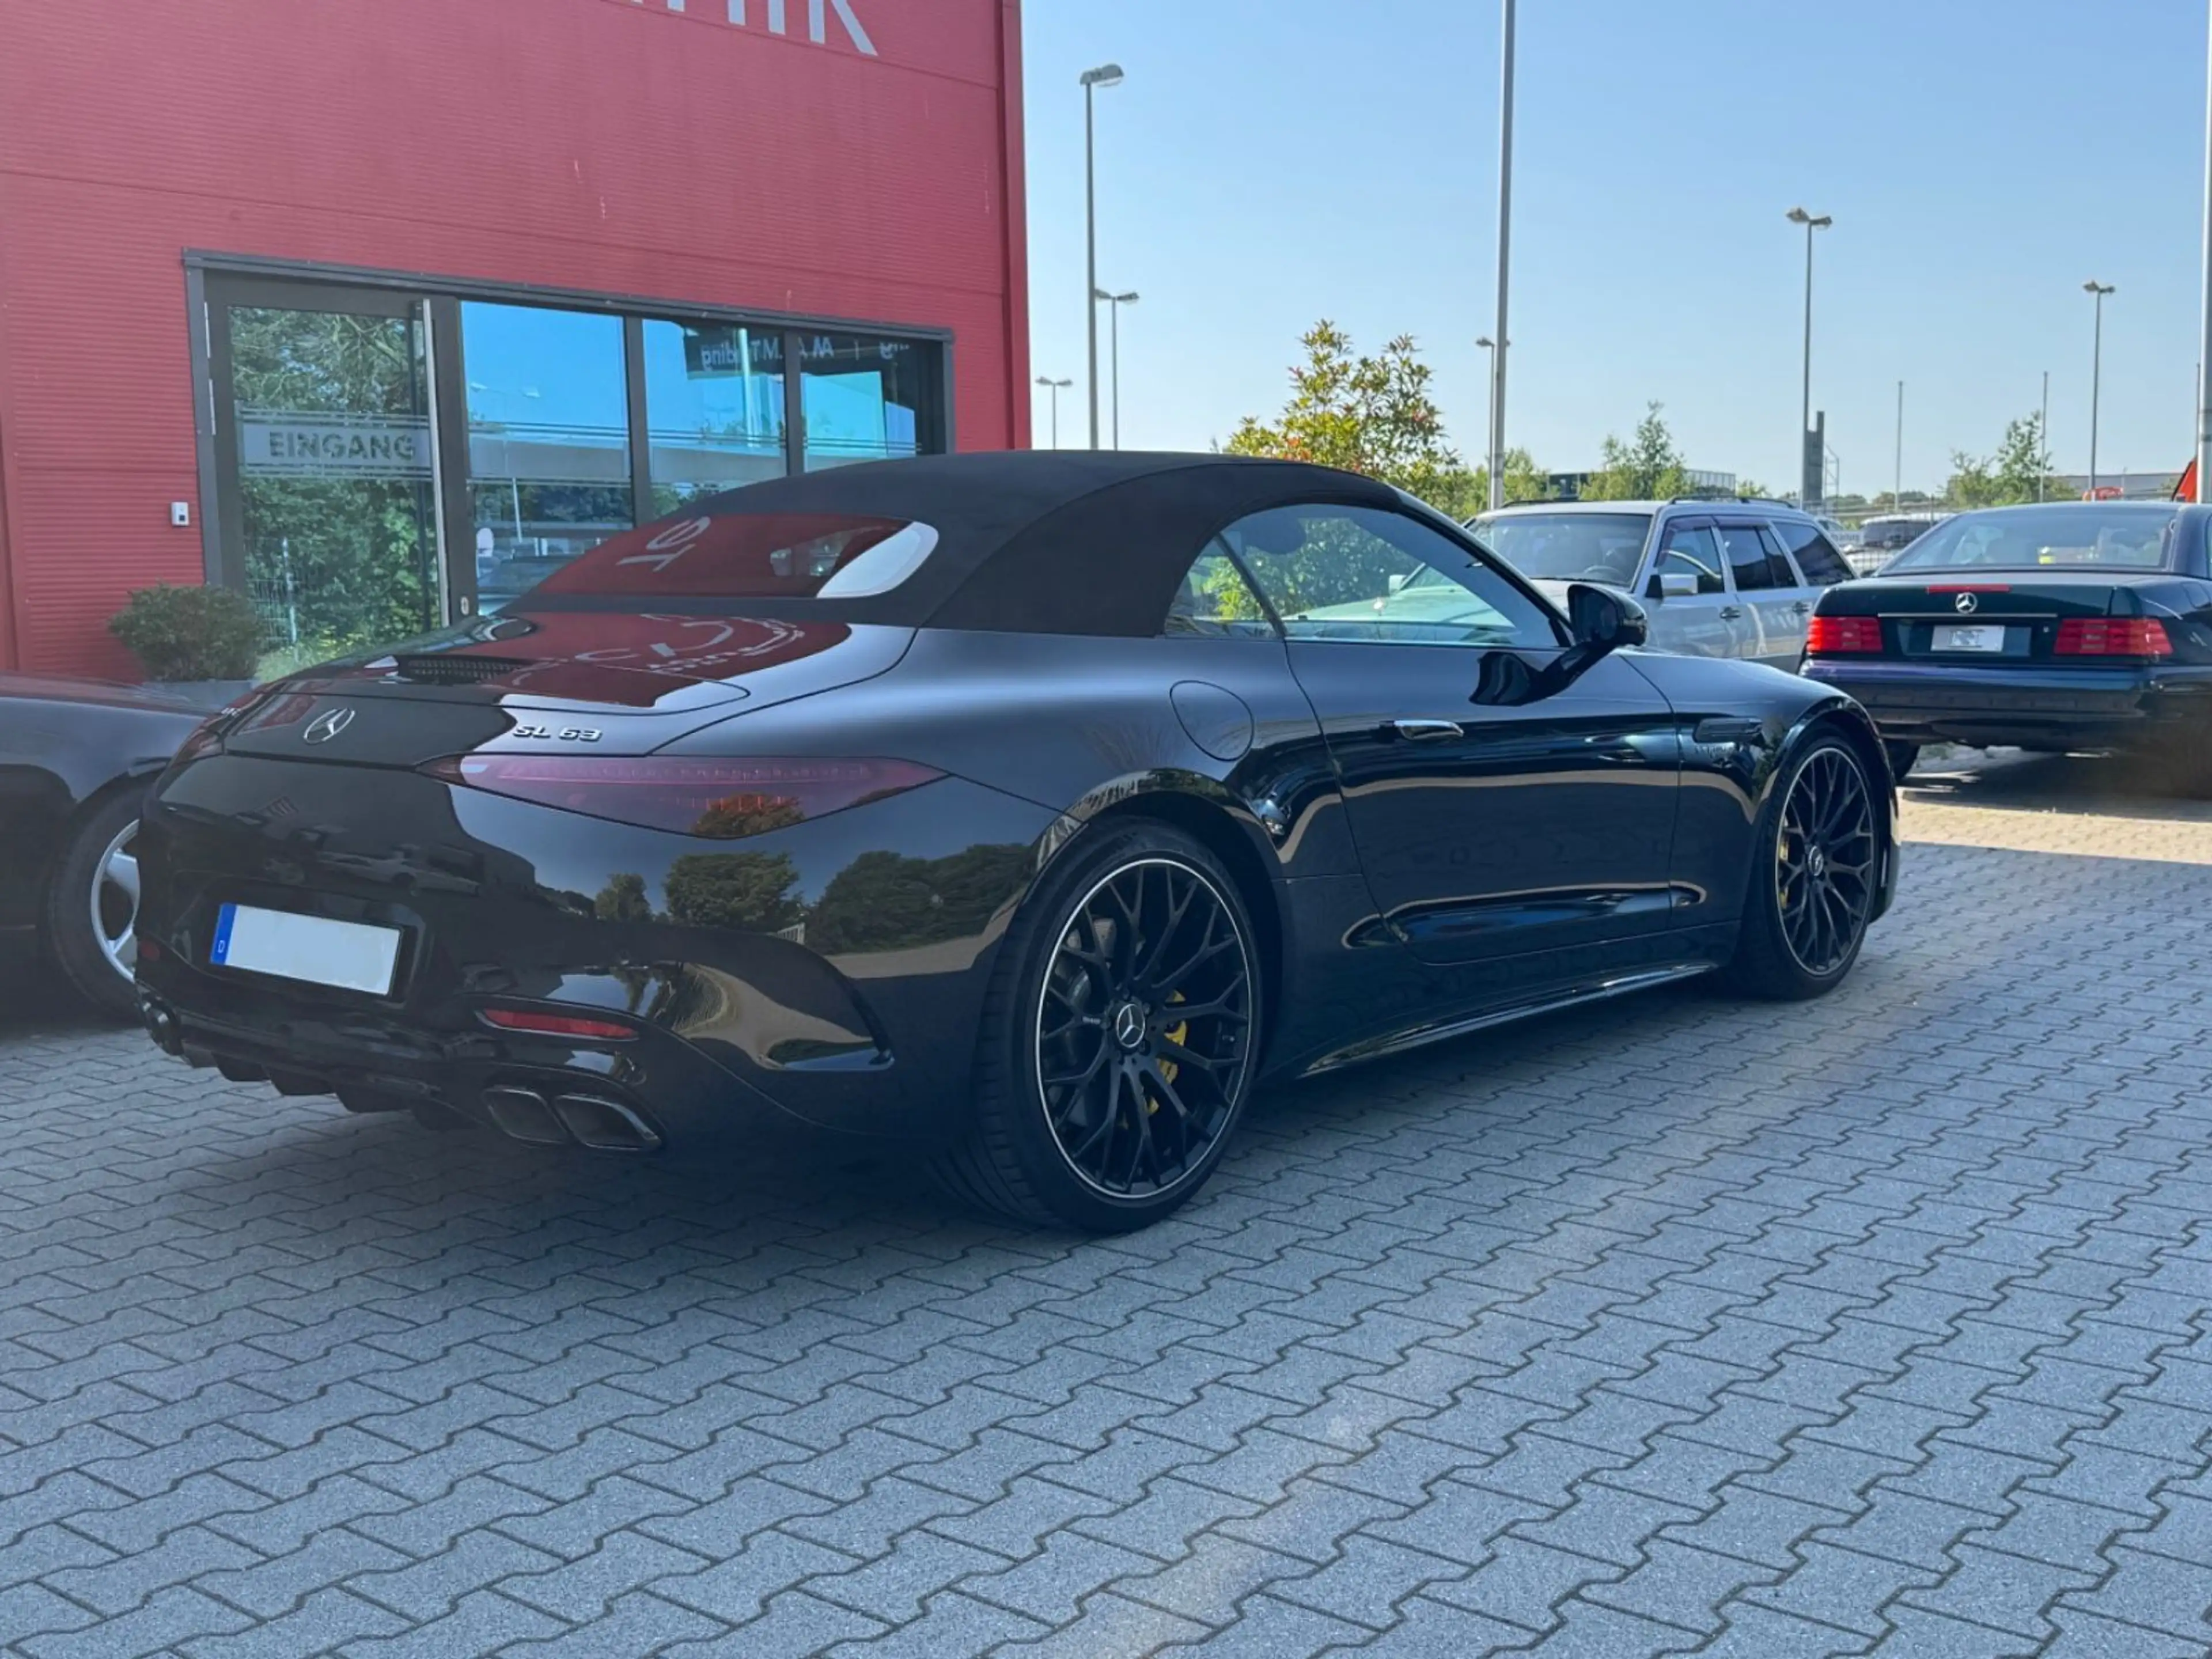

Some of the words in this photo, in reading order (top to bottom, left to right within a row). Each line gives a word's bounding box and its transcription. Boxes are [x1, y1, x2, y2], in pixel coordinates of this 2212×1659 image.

[269, 431, 414, 461] EINGANG
[512, 725, 551, 738] SL
[558, 727, 603, 742] 63
